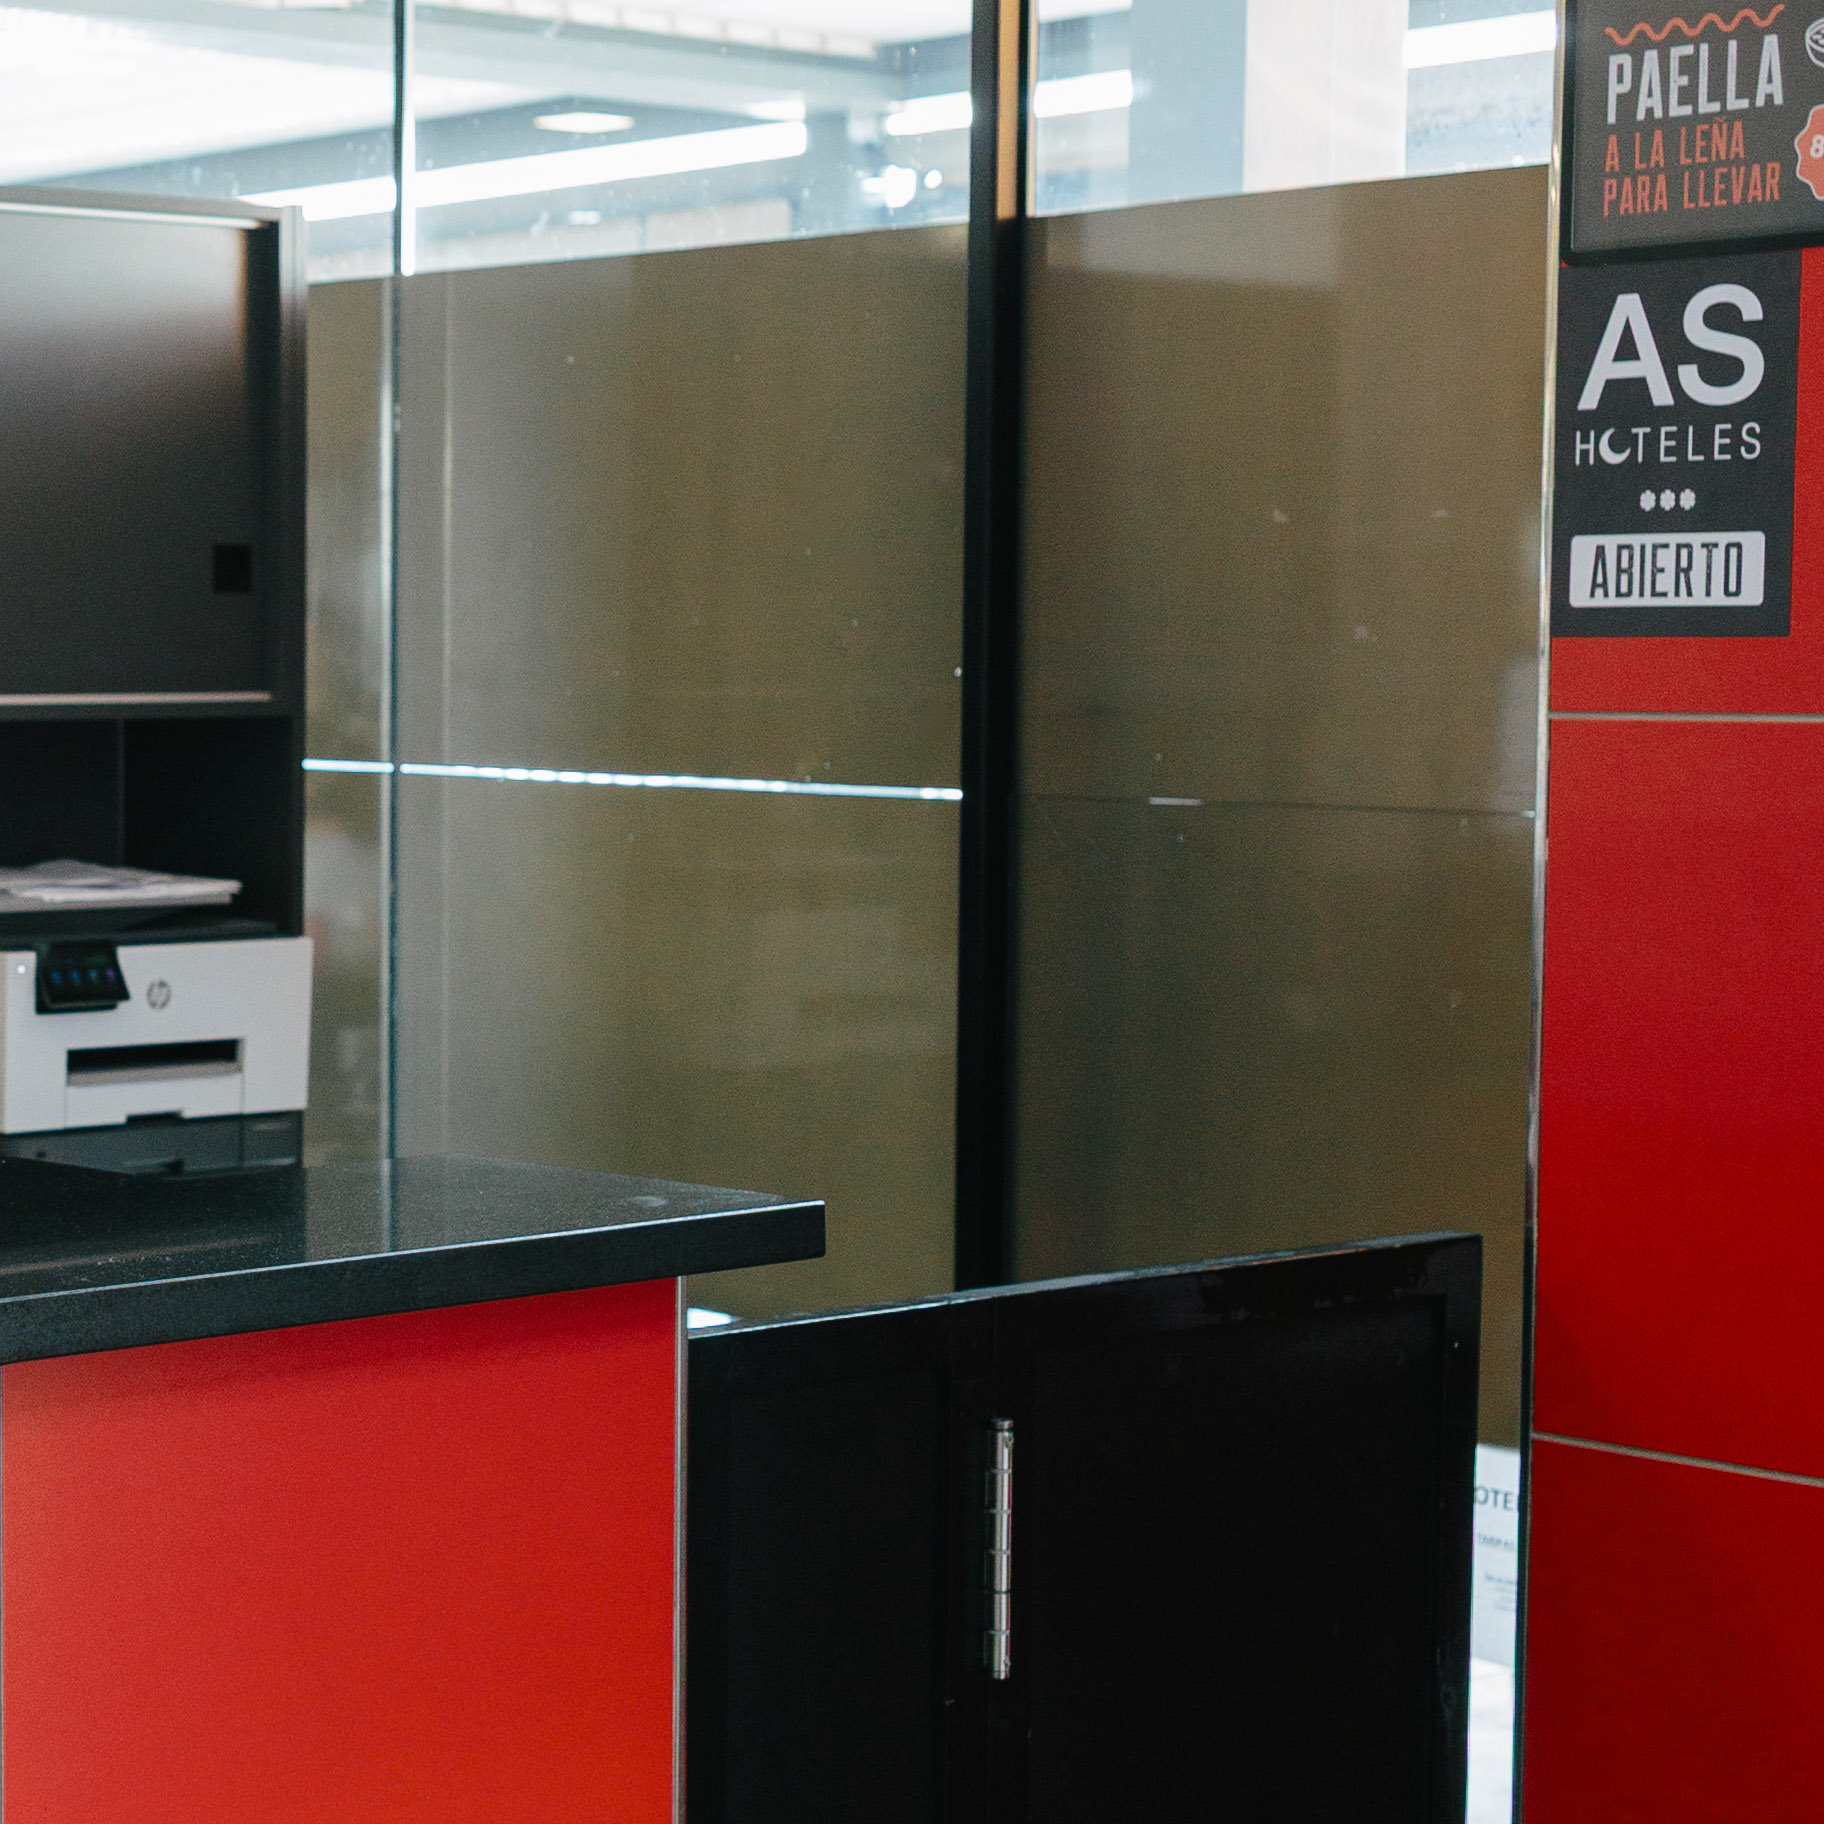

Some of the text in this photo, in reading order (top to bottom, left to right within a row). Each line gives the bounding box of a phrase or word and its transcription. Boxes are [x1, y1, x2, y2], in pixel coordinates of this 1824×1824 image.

[1607, 34, 1783, 125] PAELLA
[1605, 116, 1745, 173] A LA LEÑA
[1603, 161, 1781, 217] PARA LLEVAR
[1577, 283, 1765, 411] AS
[1575, 422, 1761, 466] HOTELES
[1589, 542, 1743, 599] ABIERTO
[1475, 1485, 1518, 1511] OTE
